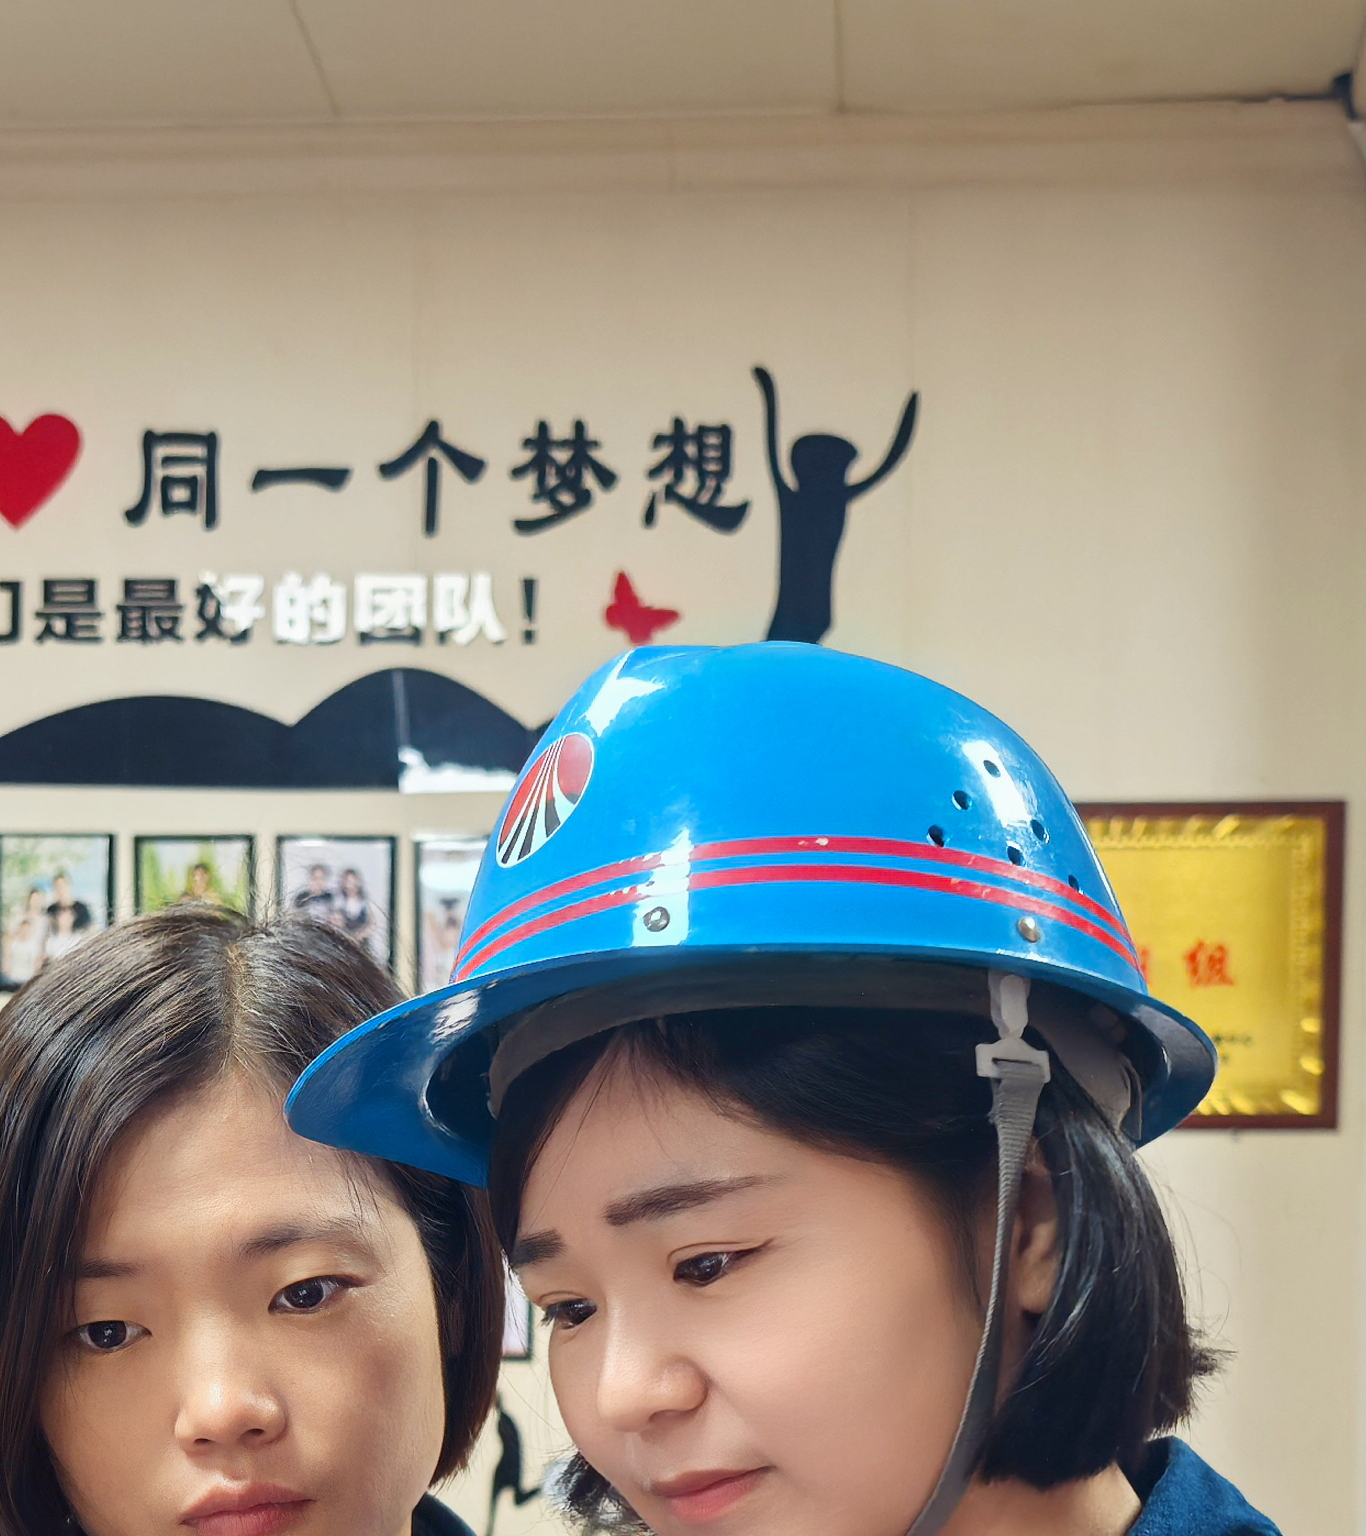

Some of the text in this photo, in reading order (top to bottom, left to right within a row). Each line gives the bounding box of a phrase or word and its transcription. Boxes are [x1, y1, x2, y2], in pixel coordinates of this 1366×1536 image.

[124, 416, 750, 538] 同一个梦想
